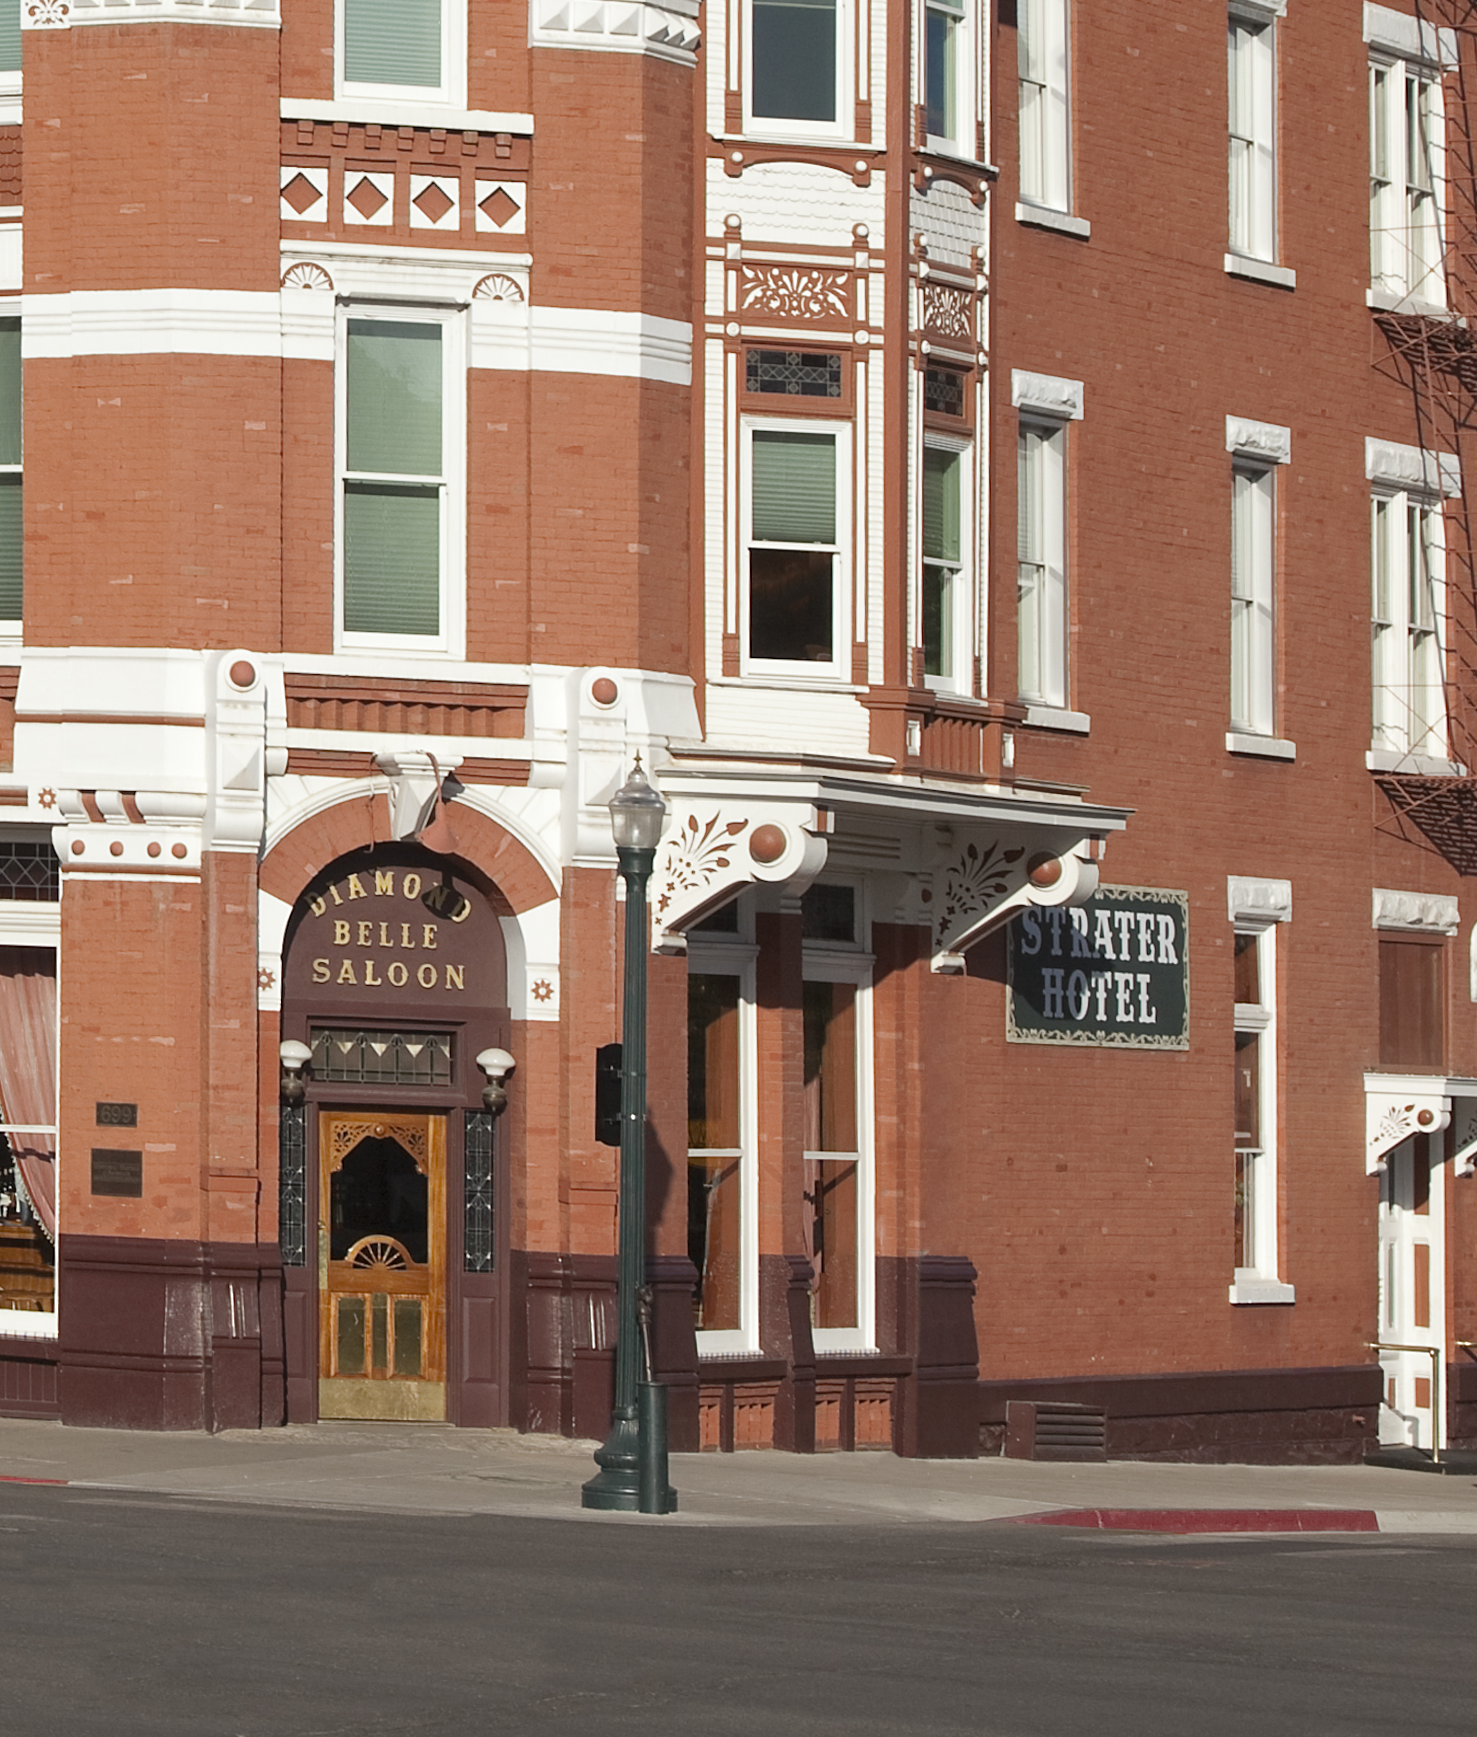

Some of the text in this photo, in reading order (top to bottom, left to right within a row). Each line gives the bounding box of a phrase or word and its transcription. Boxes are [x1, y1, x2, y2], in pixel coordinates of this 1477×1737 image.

[303, 870, 472, 923] DIAMOND
[333, 919, 438, 949] BELLE
[1021, 905, 1178, 965] STRATER
[312, 958, 465, 990] SALOON
[1041, 967, 1157, 1024] HOTEL
[101, 1105, 132, 1123] 699
